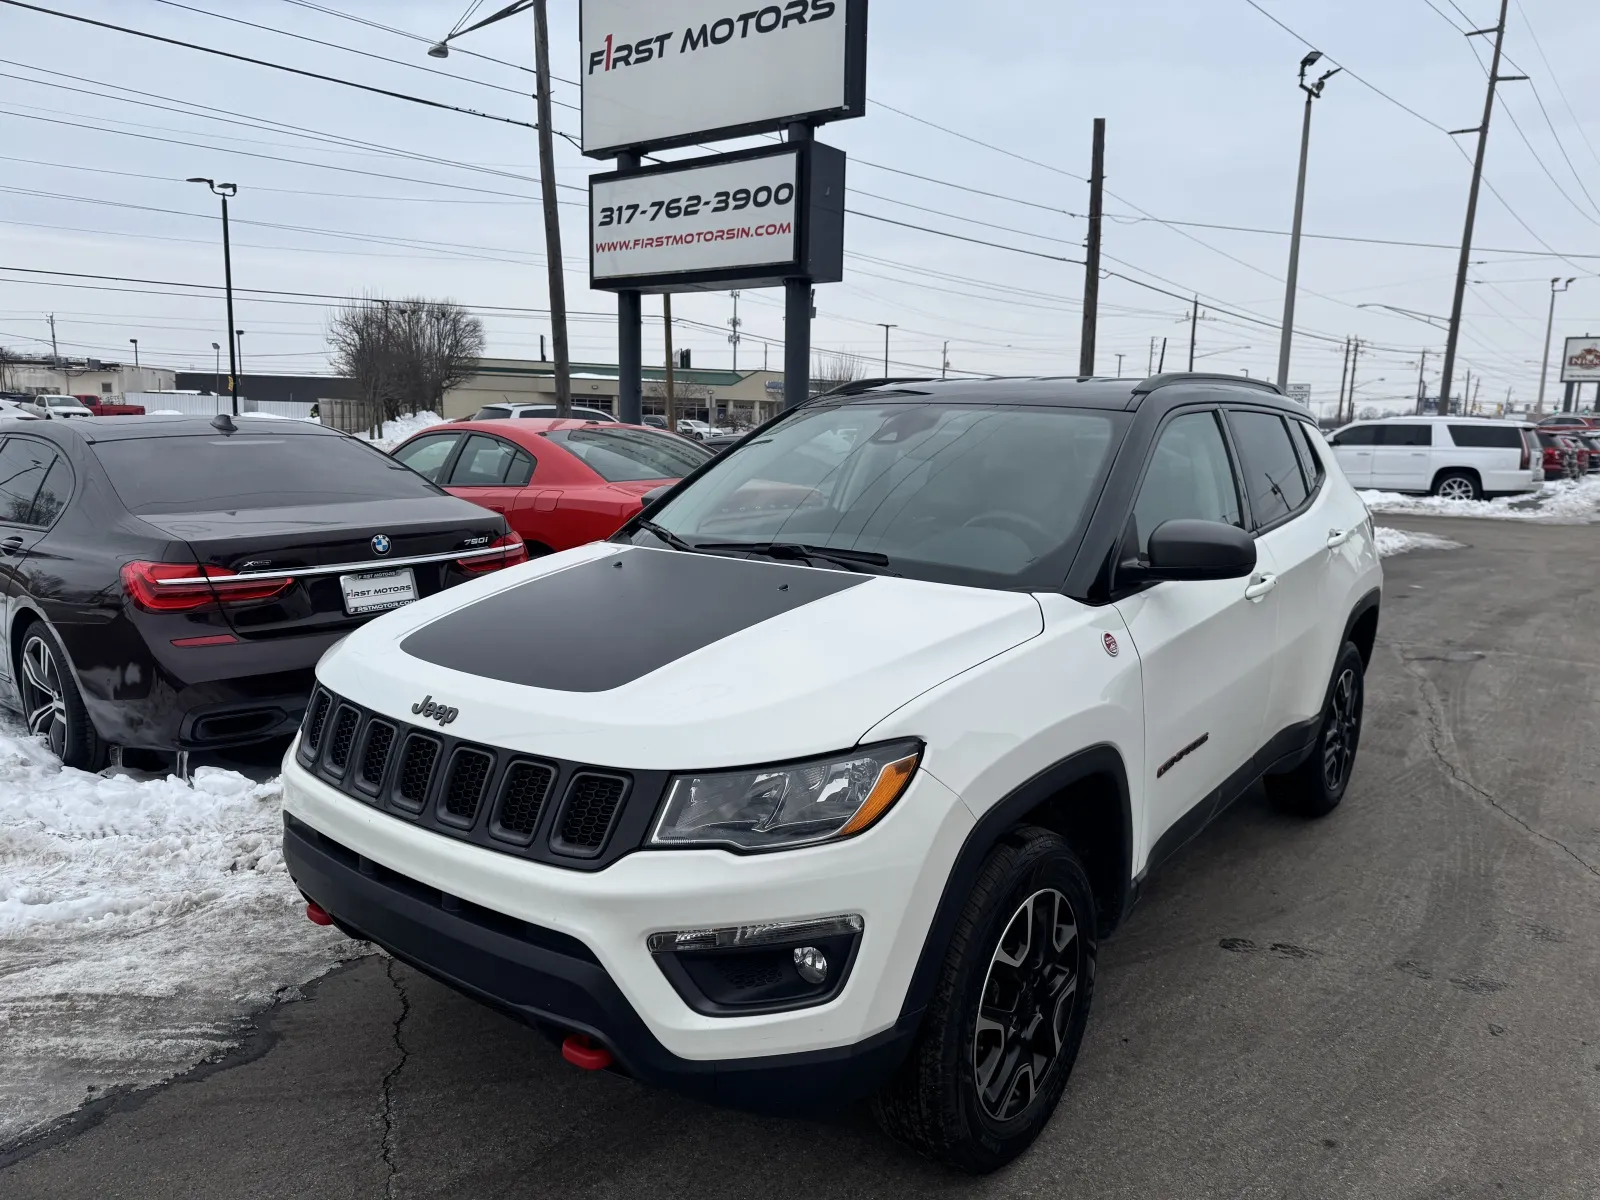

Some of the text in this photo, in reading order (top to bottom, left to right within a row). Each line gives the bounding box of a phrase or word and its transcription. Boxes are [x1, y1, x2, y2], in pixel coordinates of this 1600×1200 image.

[680, 0, 836, 54] MOTORS
[598, 183, 795, 227] 317-762-3900
[595, 222, 791, 253] WWW.FIRSTMOTORSIN.COM
[464, 537, 489, 546] 750i
[374, 584, 412, 595] MOTORS
[411, 694, 459, 727] Jeep
